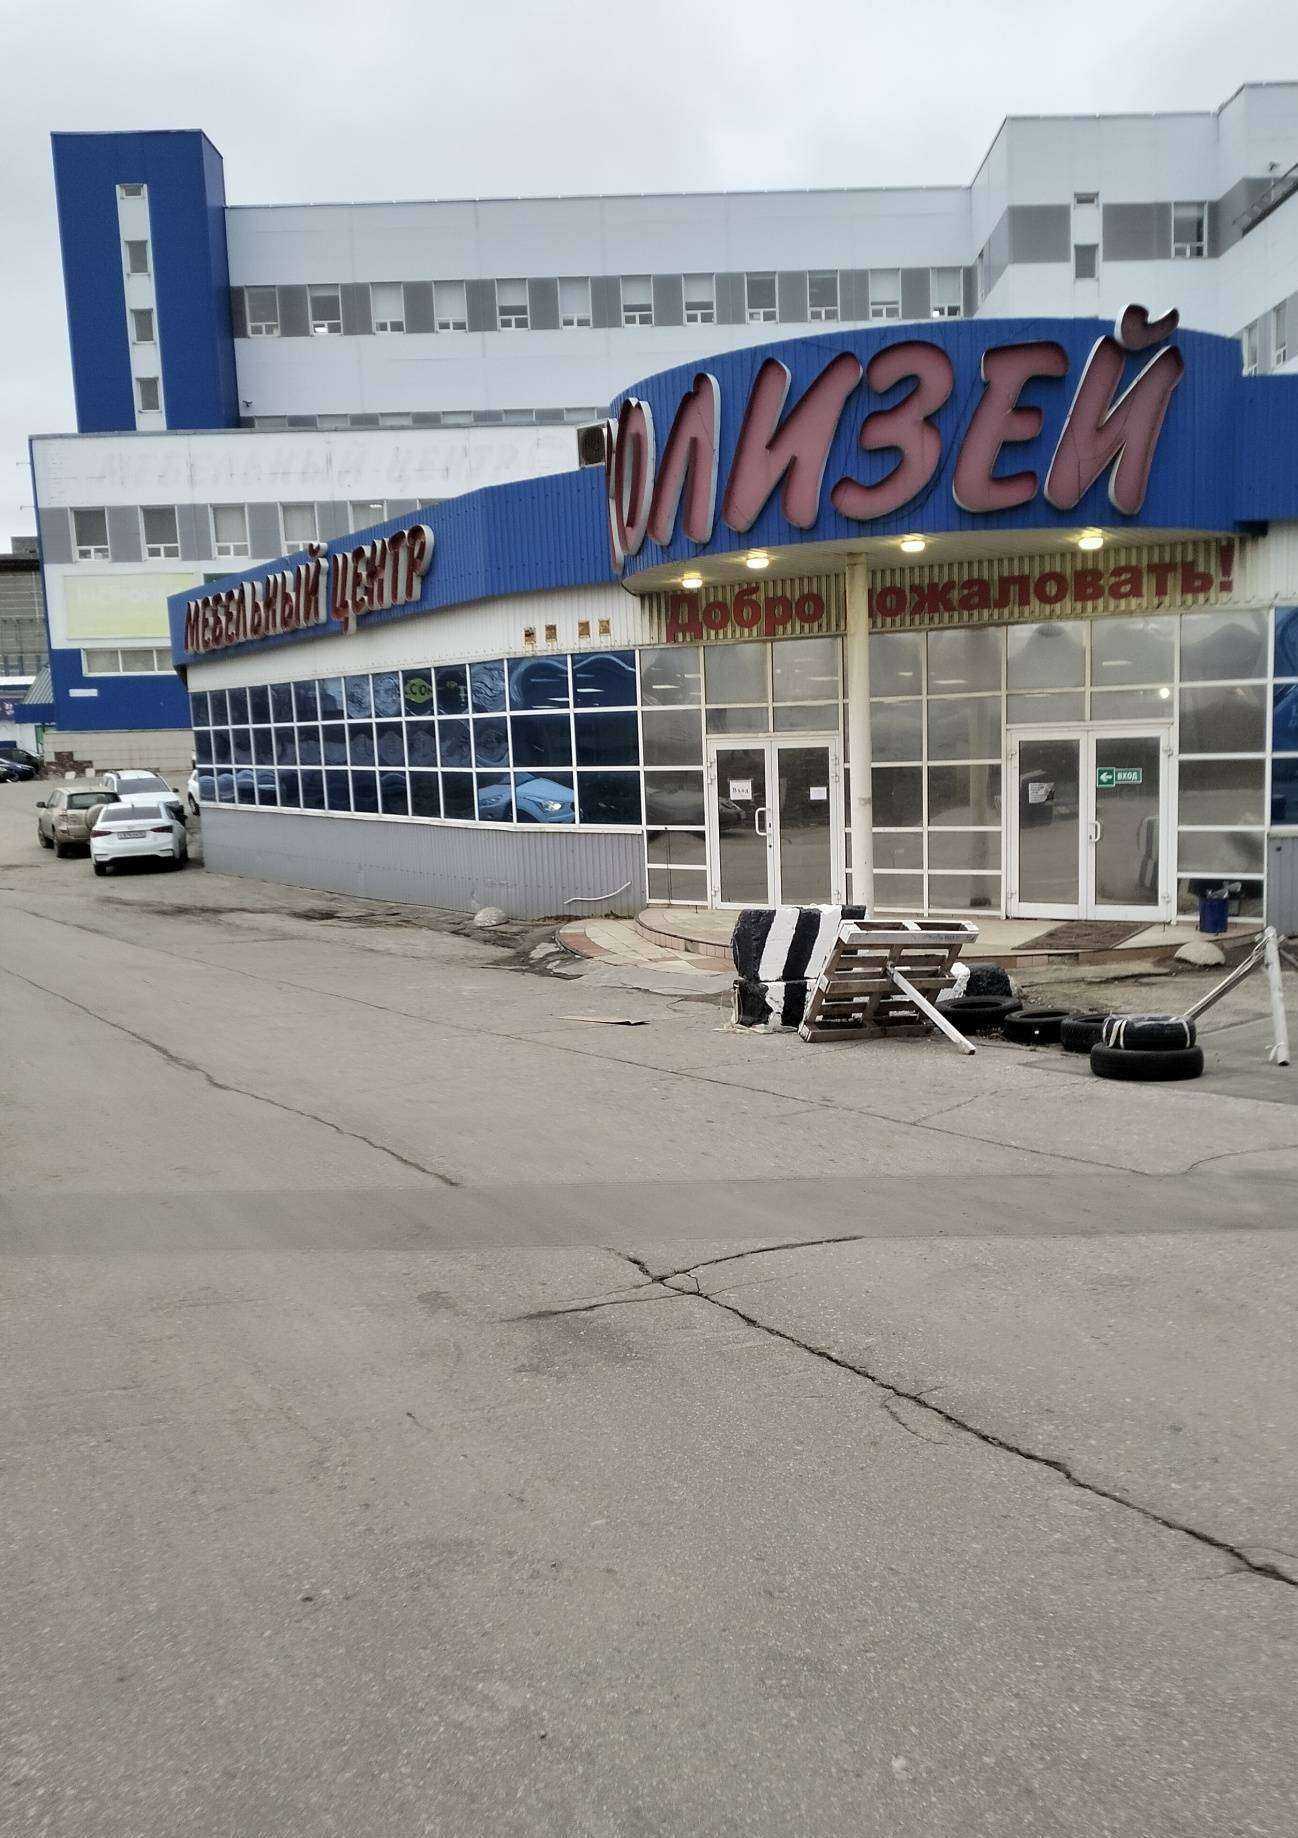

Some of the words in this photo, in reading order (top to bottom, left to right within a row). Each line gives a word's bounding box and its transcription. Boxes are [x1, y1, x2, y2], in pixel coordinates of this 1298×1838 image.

[184, 542, 328, 654] МЕБЕЛЬНЫЙ
[332, 524, 435, 636] ЦЕНТР
[666, 586, 825, 643] Добро
[864, 546, 1234, 619] ожаловать!
